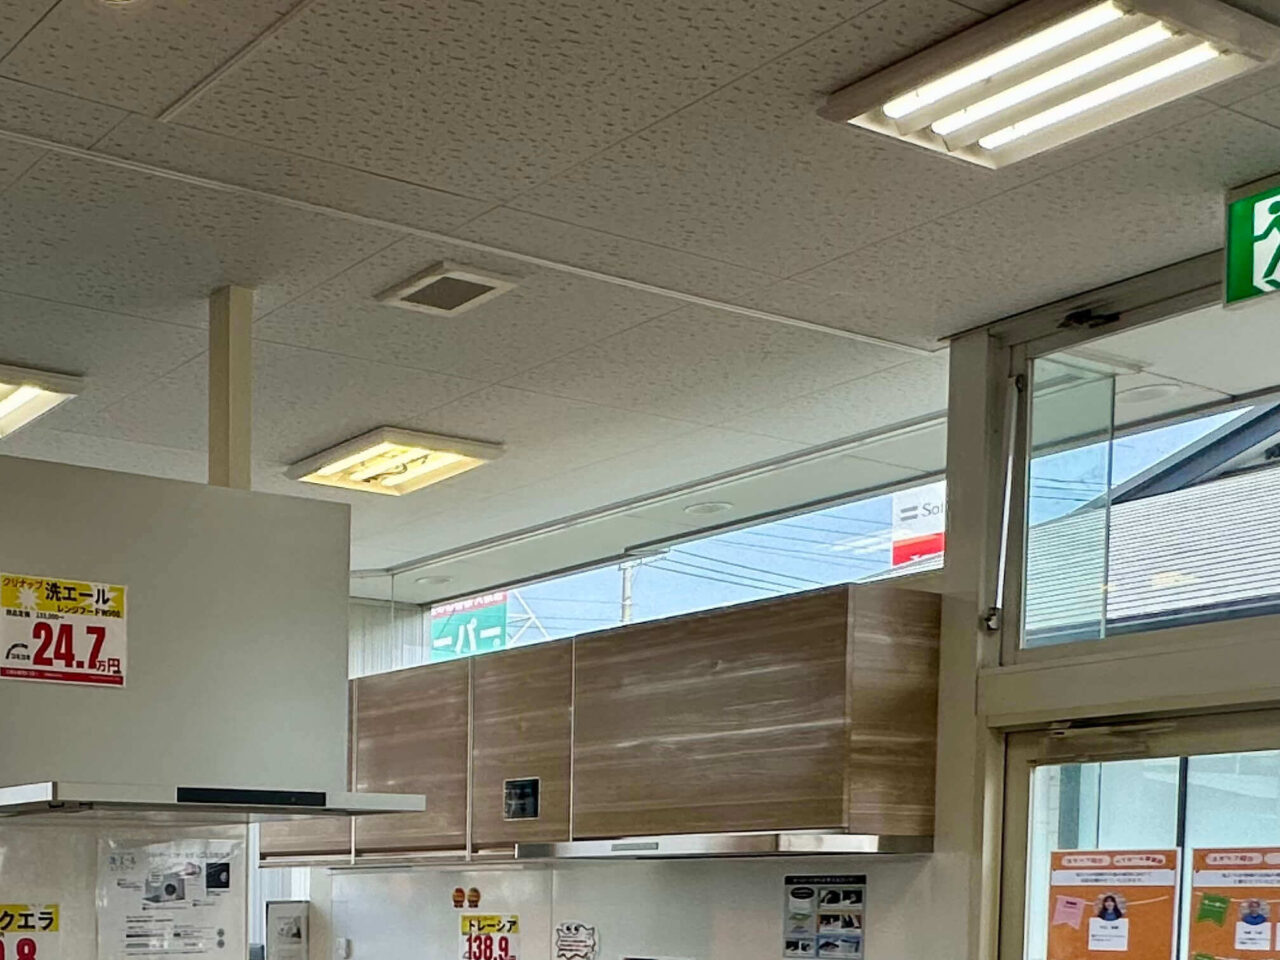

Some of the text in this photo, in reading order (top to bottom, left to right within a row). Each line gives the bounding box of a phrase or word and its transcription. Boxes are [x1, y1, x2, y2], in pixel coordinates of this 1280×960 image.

[45, 582, 110, 605] 洗エール
[469, 919, 517, 934] トレーシア
